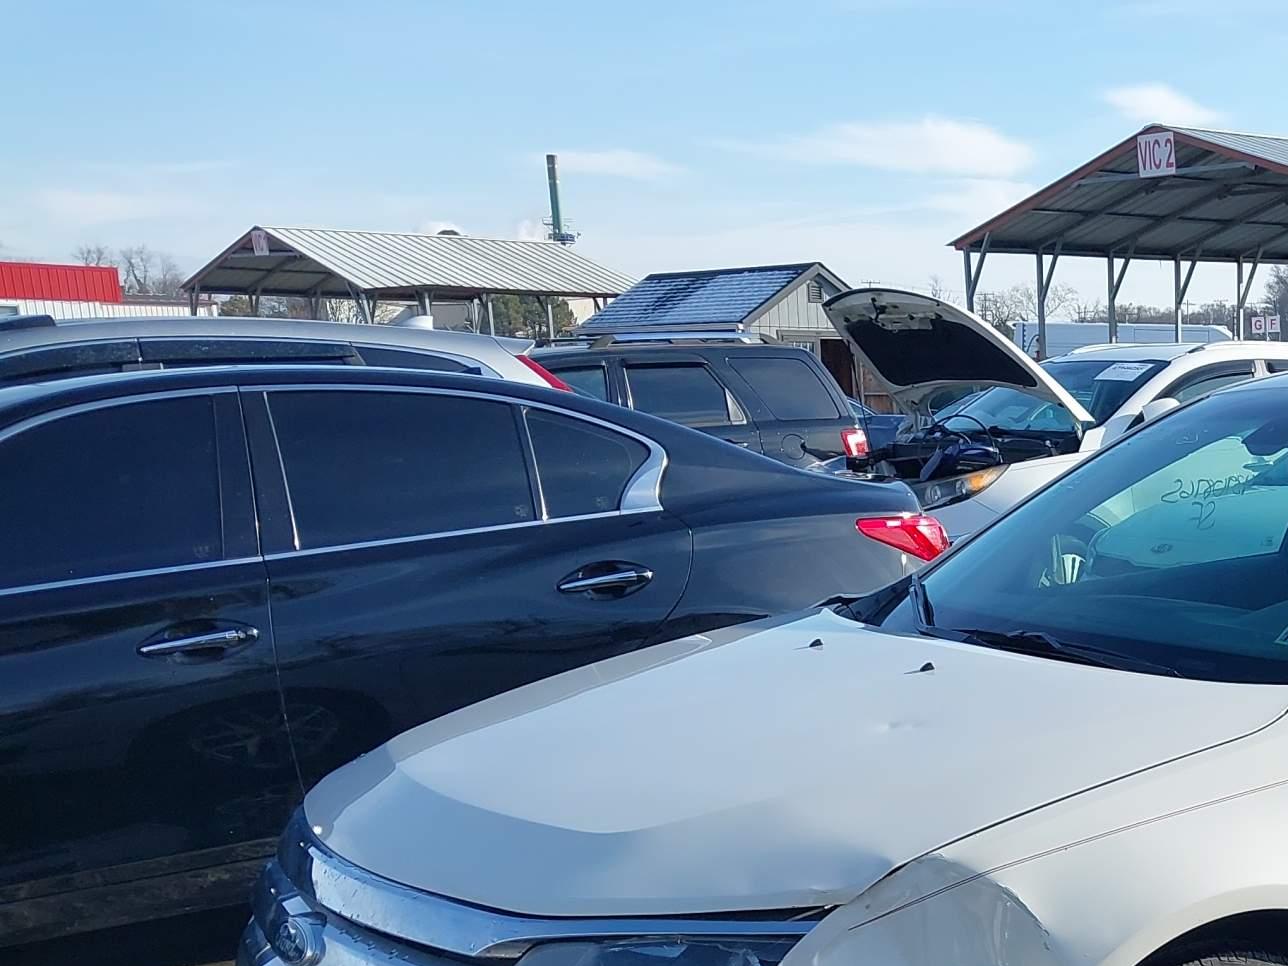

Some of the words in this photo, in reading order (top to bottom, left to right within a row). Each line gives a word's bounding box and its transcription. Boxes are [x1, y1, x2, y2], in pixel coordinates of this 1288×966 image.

[1138, 138, 1162, 170] VIC
[1164, 137, 1175, 169] 2
[1254, 319, 1263, 331] G
[1270, 318, 1277, 330] F
